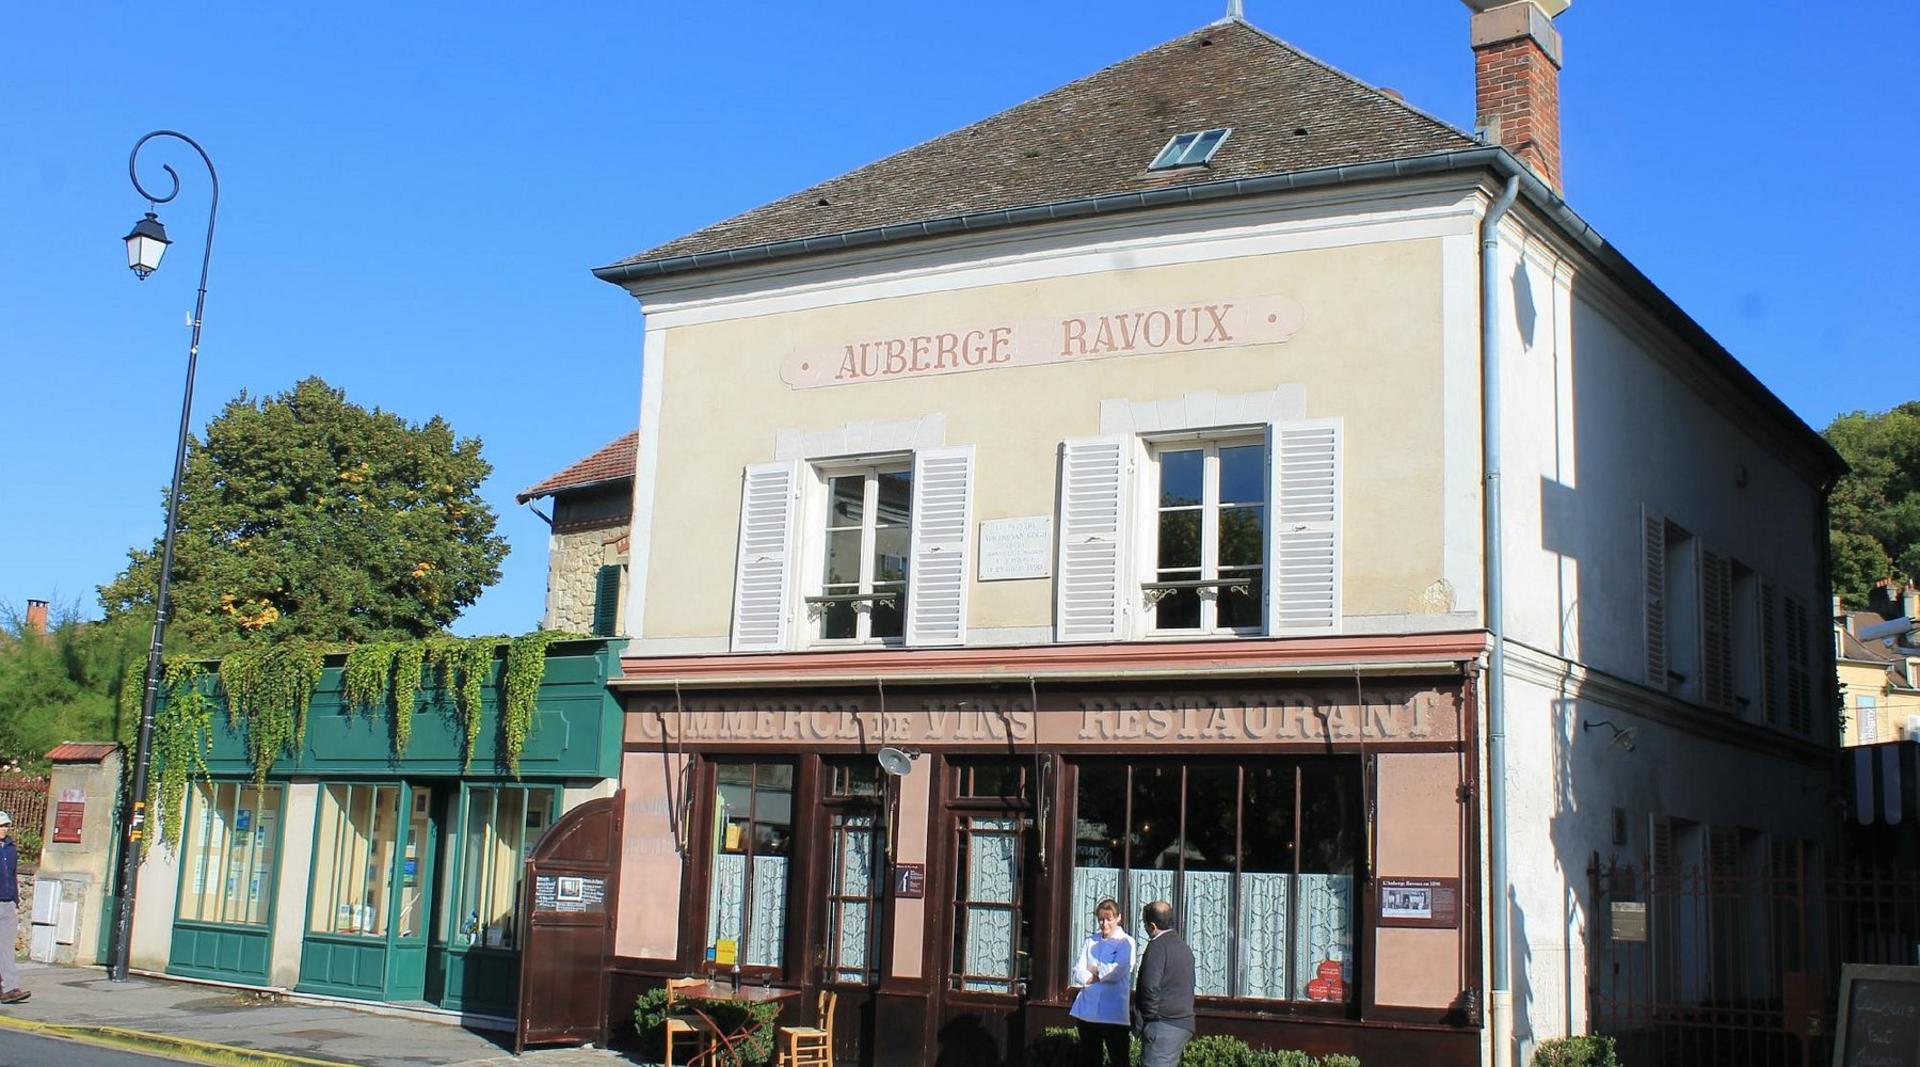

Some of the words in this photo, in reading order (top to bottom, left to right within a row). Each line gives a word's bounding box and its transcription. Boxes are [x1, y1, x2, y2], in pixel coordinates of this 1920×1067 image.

[835, 327, 1012, 381] AUBERGE
[1061, 303, 1234, 356] RAVOUX
[640, 700, 865, 741] COMMERCE
[870, 709, 911, 740] DE
[920, 699, 1034, 740] VINS
[1077, 690, 1438, 740] RESTAURANT
